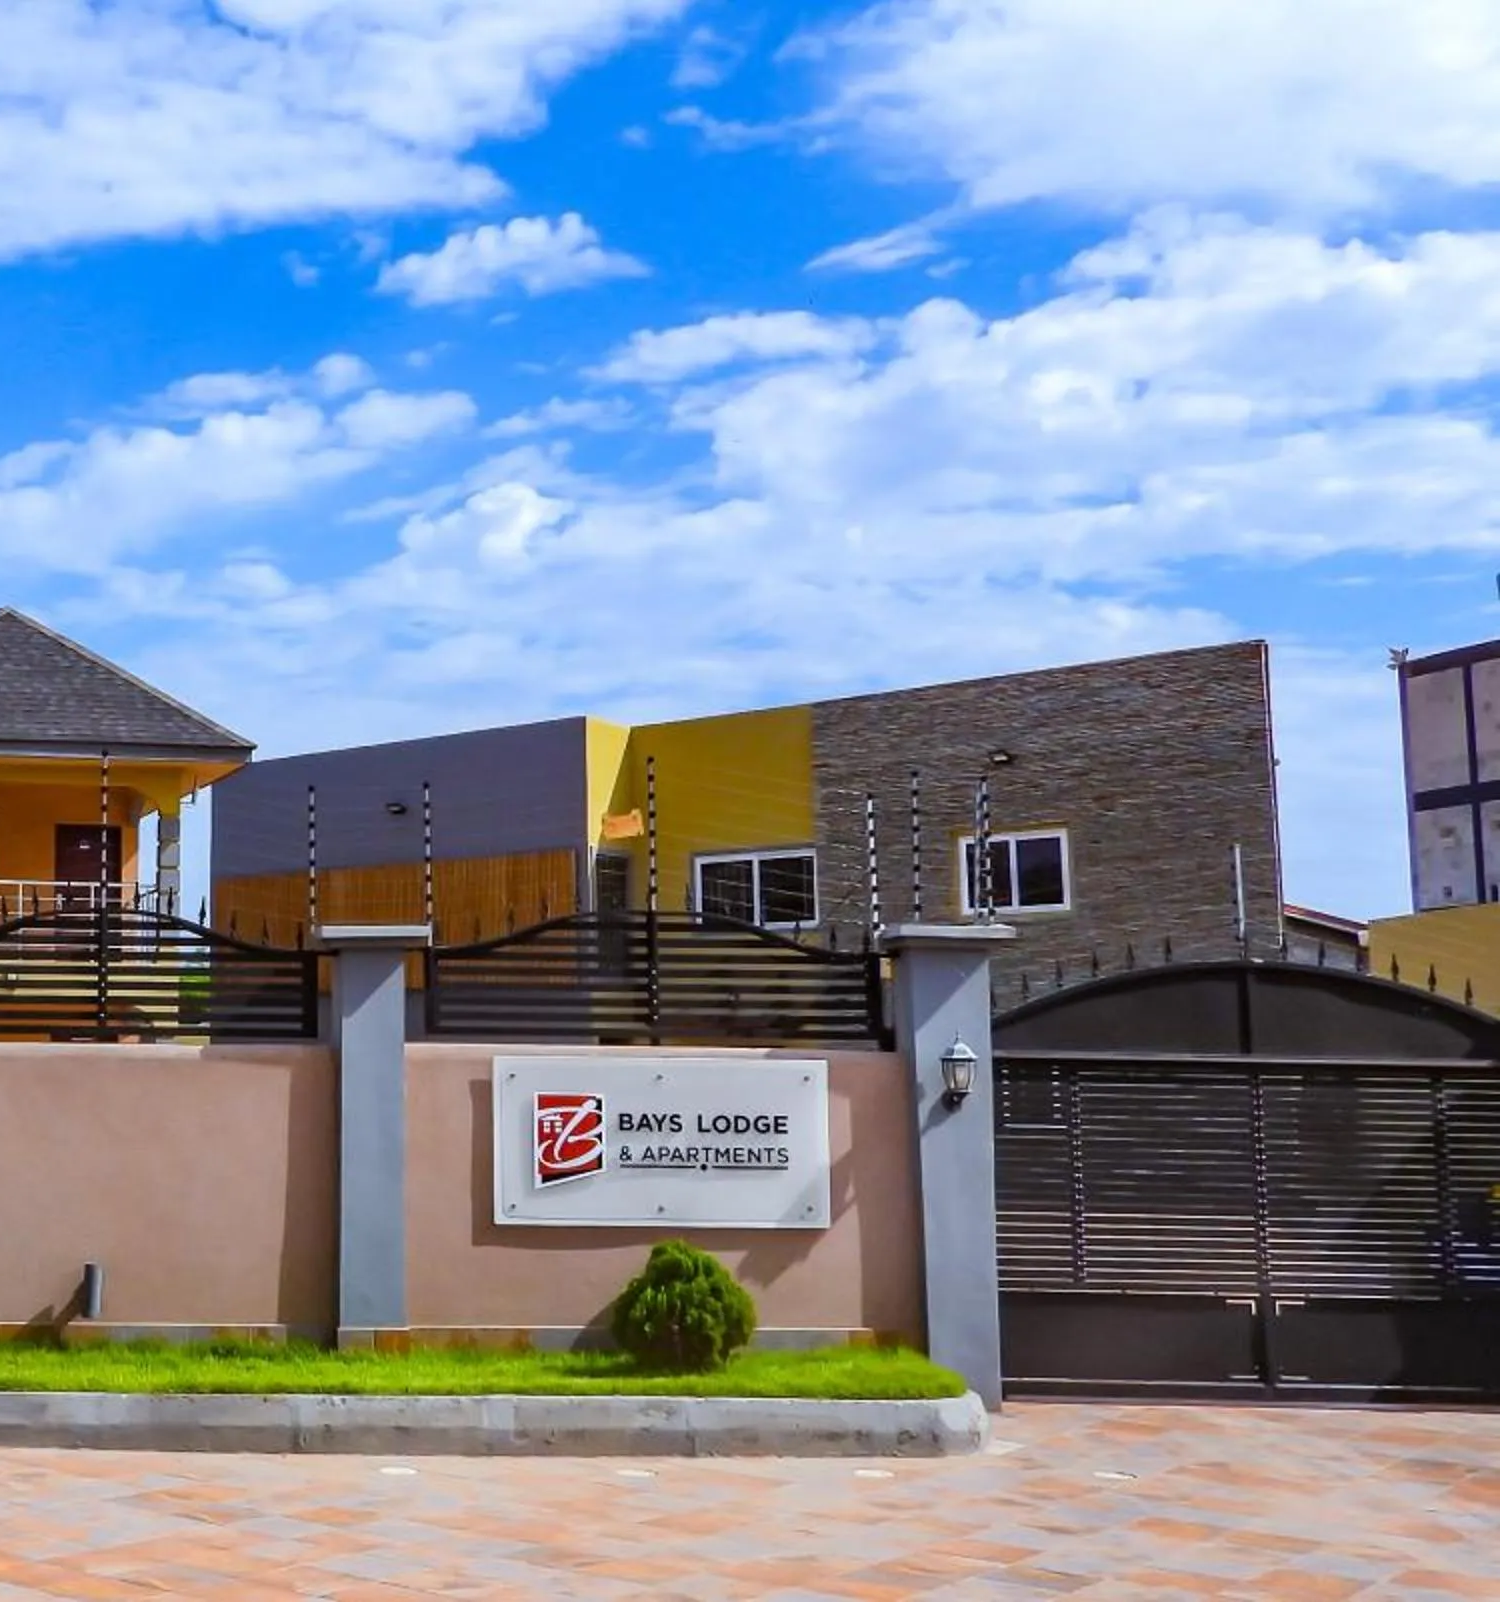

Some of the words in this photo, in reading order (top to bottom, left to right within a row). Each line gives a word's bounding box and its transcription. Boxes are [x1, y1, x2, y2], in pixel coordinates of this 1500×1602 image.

[618, 1113, 683, 1132] BAYS
[697, 1114, 789, 1135] LODGE
[618, 1146, 633, 1161] &
[642, 1147, 790, 1164] APARTMENTS
